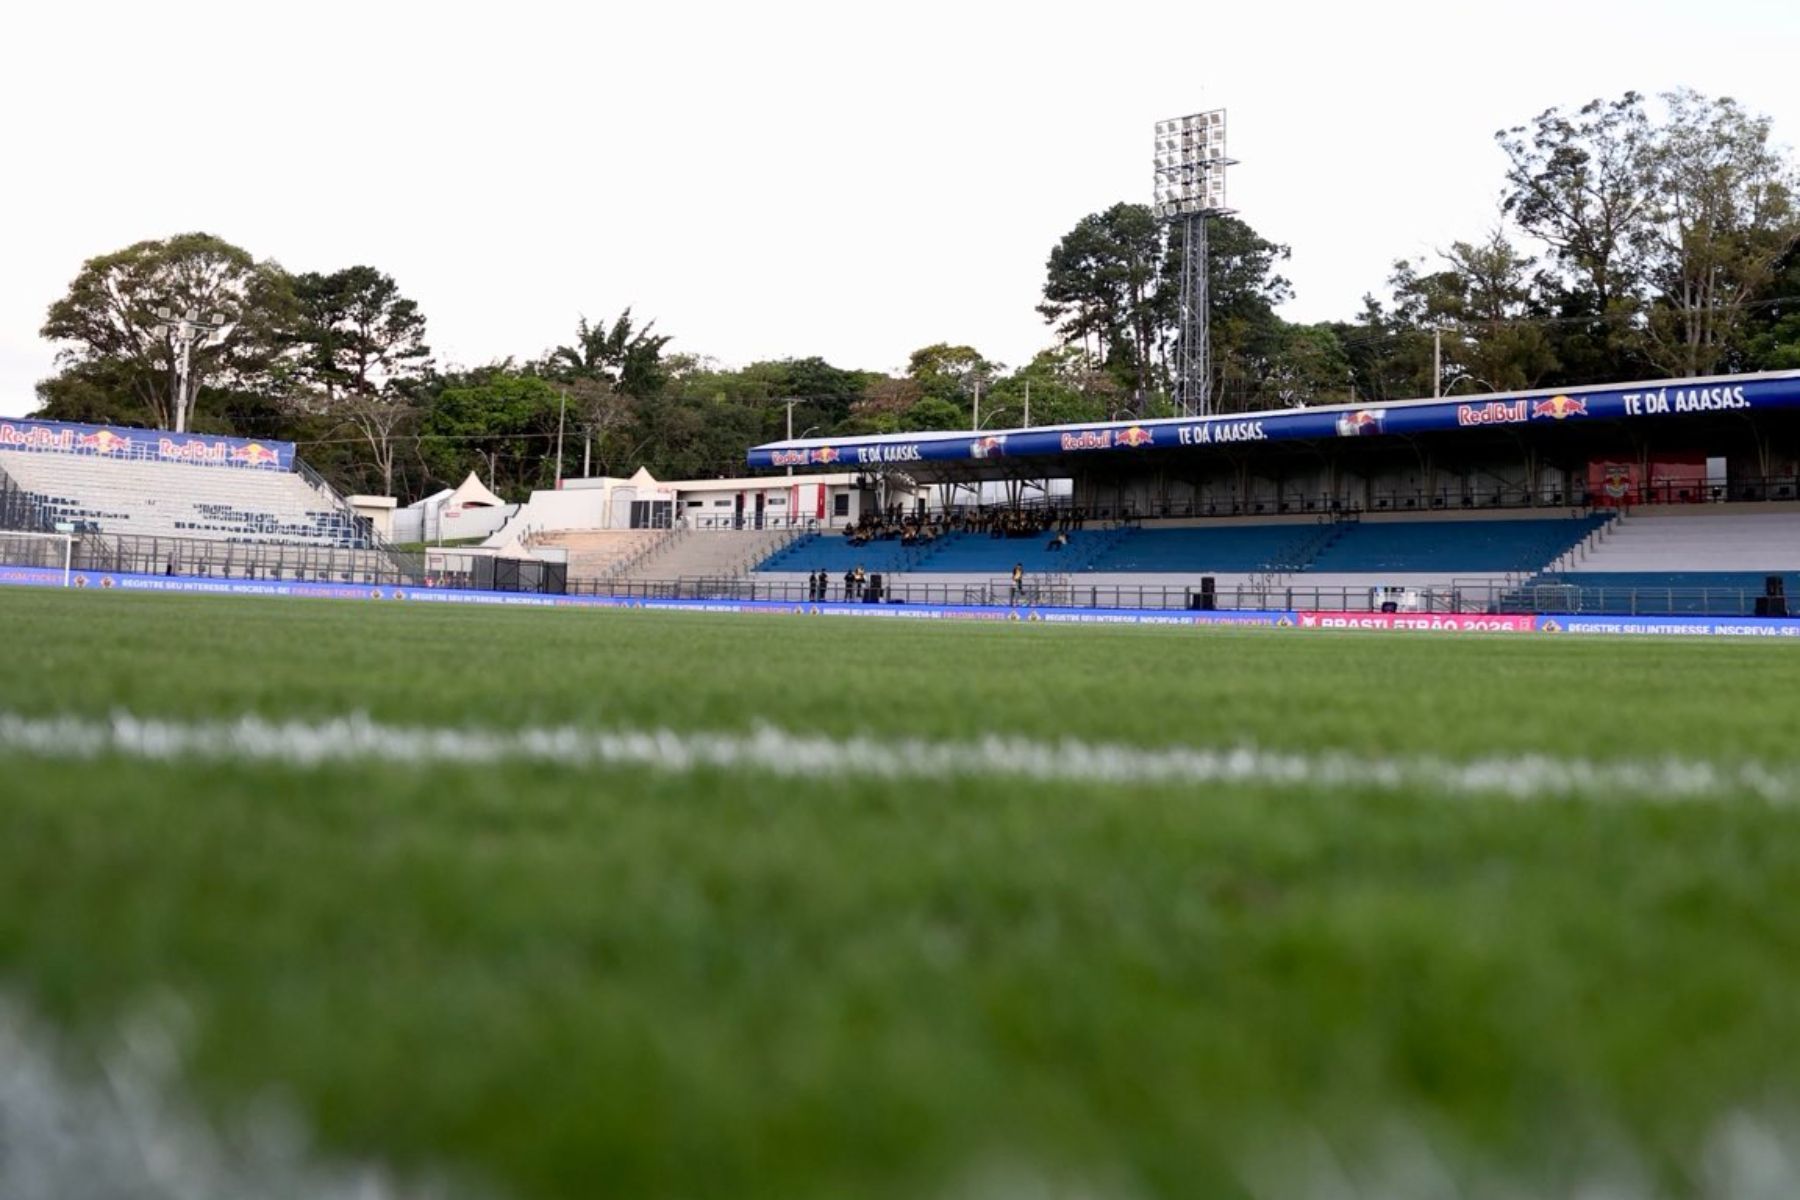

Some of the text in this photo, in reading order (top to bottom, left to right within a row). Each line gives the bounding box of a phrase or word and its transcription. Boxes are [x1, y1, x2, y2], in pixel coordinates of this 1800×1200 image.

[1623, 386, 1751, 415] TE DÁ AAASAS.
[1178, 421, 1268, 445] TE DÁ AAASAS.
[857, 448, 868, 463] TE
[1463, 620, 1513, 631] 2026
[1568, 623, 1623, 633] REGISTRE
[1624, 624, 1647, 633] SEU
